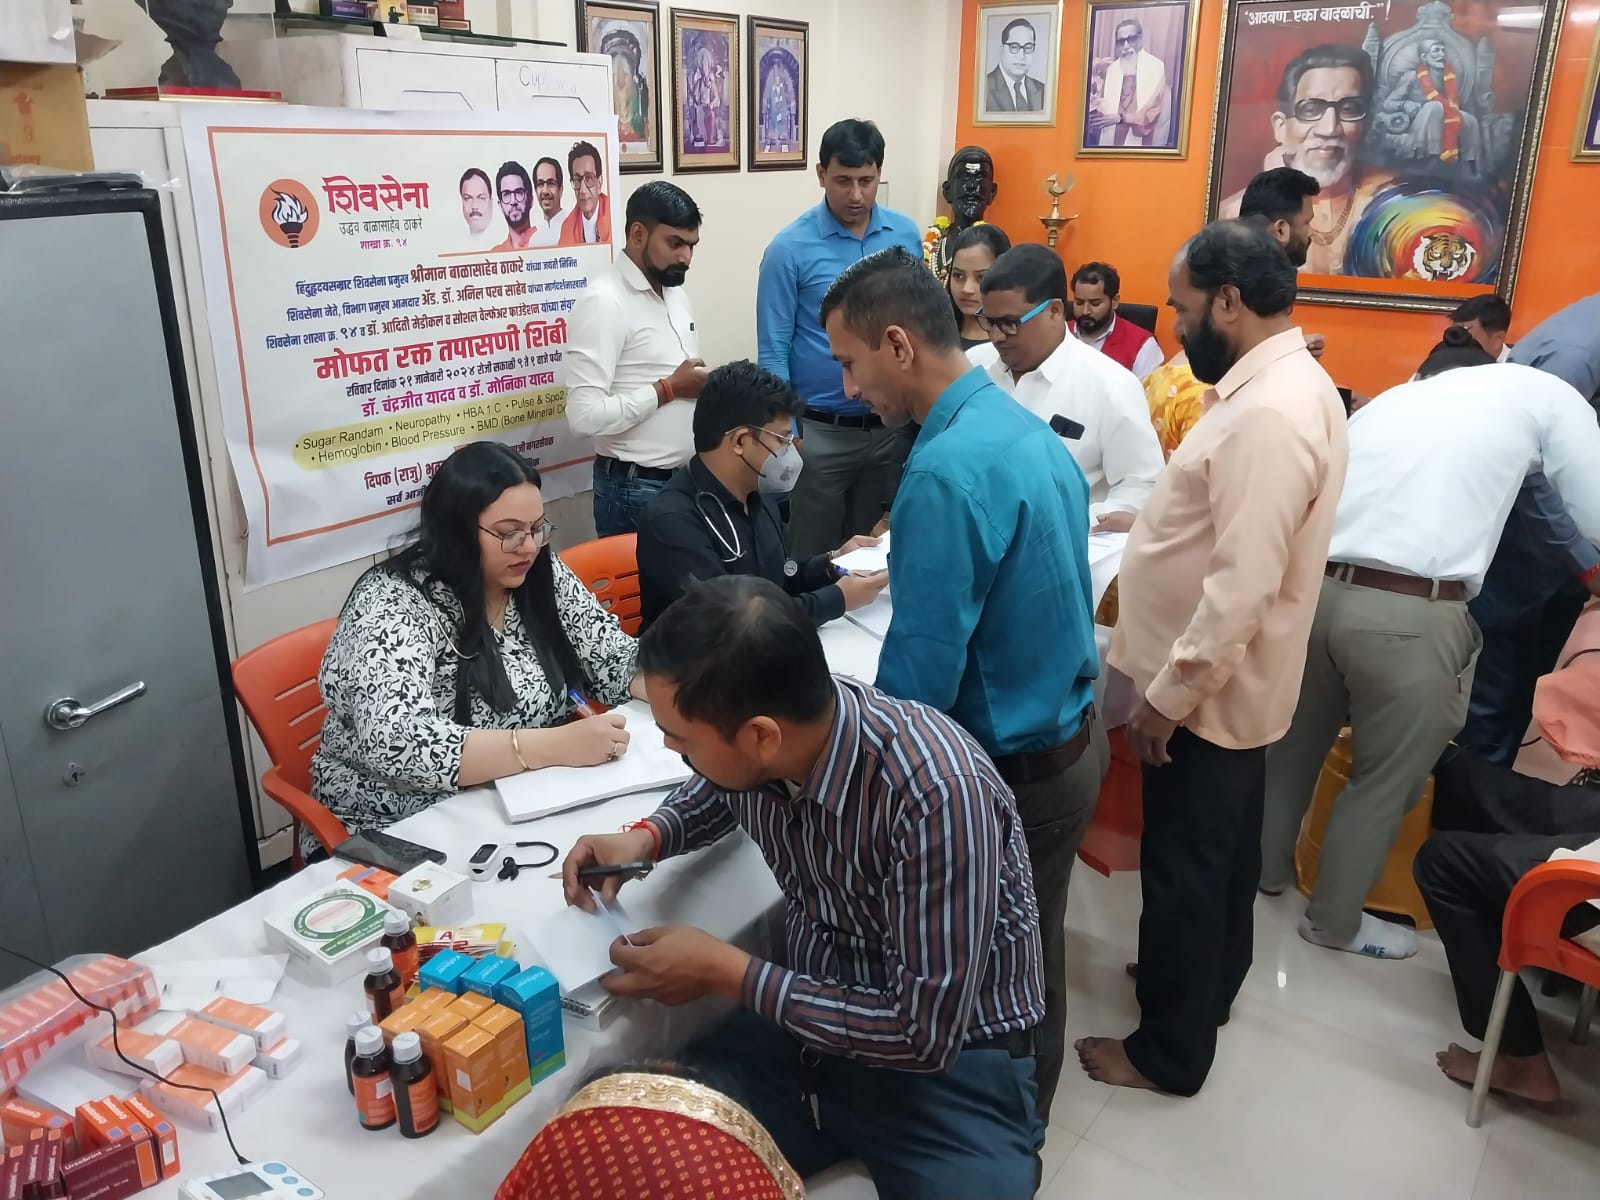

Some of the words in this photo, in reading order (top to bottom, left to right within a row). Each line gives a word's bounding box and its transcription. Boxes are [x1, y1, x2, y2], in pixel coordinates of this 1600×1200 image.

[1292, 8, 1319, 22] एका
[322, 174, 429, 214] शिवसेना
[338, 221, 359, 236] उद्धव
[362, 216, 400, 233] बाळासाहेब
[402, 214, 423, 231] ठाकरे
[360, 239, 381, 250] शाखा
[353, 275, 386, 290] शिवसेना
[388, 274, 409, 289] प्रमुख
[410, 264, 447, 283] श्रीमान
[448, 259, 498, 279] बाळासाहेब
[499, 256, 524, 274] ठाकरे
[526, 261, 541, 271] यांच्या
[286, 305, 323, 322] शिवसेना
[325, 303, 341, 319] नेते,
[342, 301, 367, 316] विभाग
[368, 299, 390, 315] प्रमुख
[391, 296, 420, 310] आमदार
[441, 287, 454, 304] डॉ.
[456, 285, 484, 303] अनिल
[486, 283, 503, 299] परब
[505, 280, 527, 297] साहेब
[266, 333, 302, 350] शिवसेना
[303, 331, 326, 345] शाखा
[360, 326, 367, 337] व
[367, 320, 380, 336] डॉ.
[381, 316, 410, 334] आदिती
[411, 313, 443, 332] मेडीकल
[445, 314, 452, 326] व
[452, 309, 478, 326] सोशल
[541, 299, 559, 313] यांच्या
[313, 347, 390, 379] मोफत
[393, 342, 434, 368] रक्त
[436, 324, 521, 362] तपासणी
[345, 382, 372, 397] रविवार
[373, 376, 398, 393] दिनांक
[399, 375, 412, 388] २१
[414, 367, 444, 385] जानेवारी
[446, 365, 475, 380] २०२४
[477, 360, 492, 375] रोजी
[493, 357, 516, 373] सकाळी
[524, 354, 530, 368] ते
[536, 351, 549, 367] वाजे
[361, 397, 379, 417] डॉ.
[381, 391, 424, 414] चंद्रजीत
[424, 387, 456, 405] यादव
[457, 385, 467, 399] व
[468, 380, 484, 398] डॉ.
[486, 375, 528, 394] मोनिका
[528, 371, 555, 387] यादव
[303, 435, 337, 450] Sugar
[340, 426, 384, 443] Randam
[395, 412, 451, 431] Neuropathy
[463, 405, 485, 419] HBA
[511, 397, 535, 410] Pulse
[537, 396, 542, 405] &
[545, 390, 564, 404] Spo2
[318, 441, 382, 463] Hemoglobin
[391, 433, 420, 448] Blood
[422, 425, 466, 442] Pressure
[477, 417, 499, 431] BMD
[501, 414, 525, 427] (Bone
[527, 406, 556, 422] Mineral
[364, 471, 391, 490] दिपक
[394, 462, 423, 486] (राजु)
[386, 489, 403, 505] सर्व
[1361, 944, 1386, 957] NIKE
